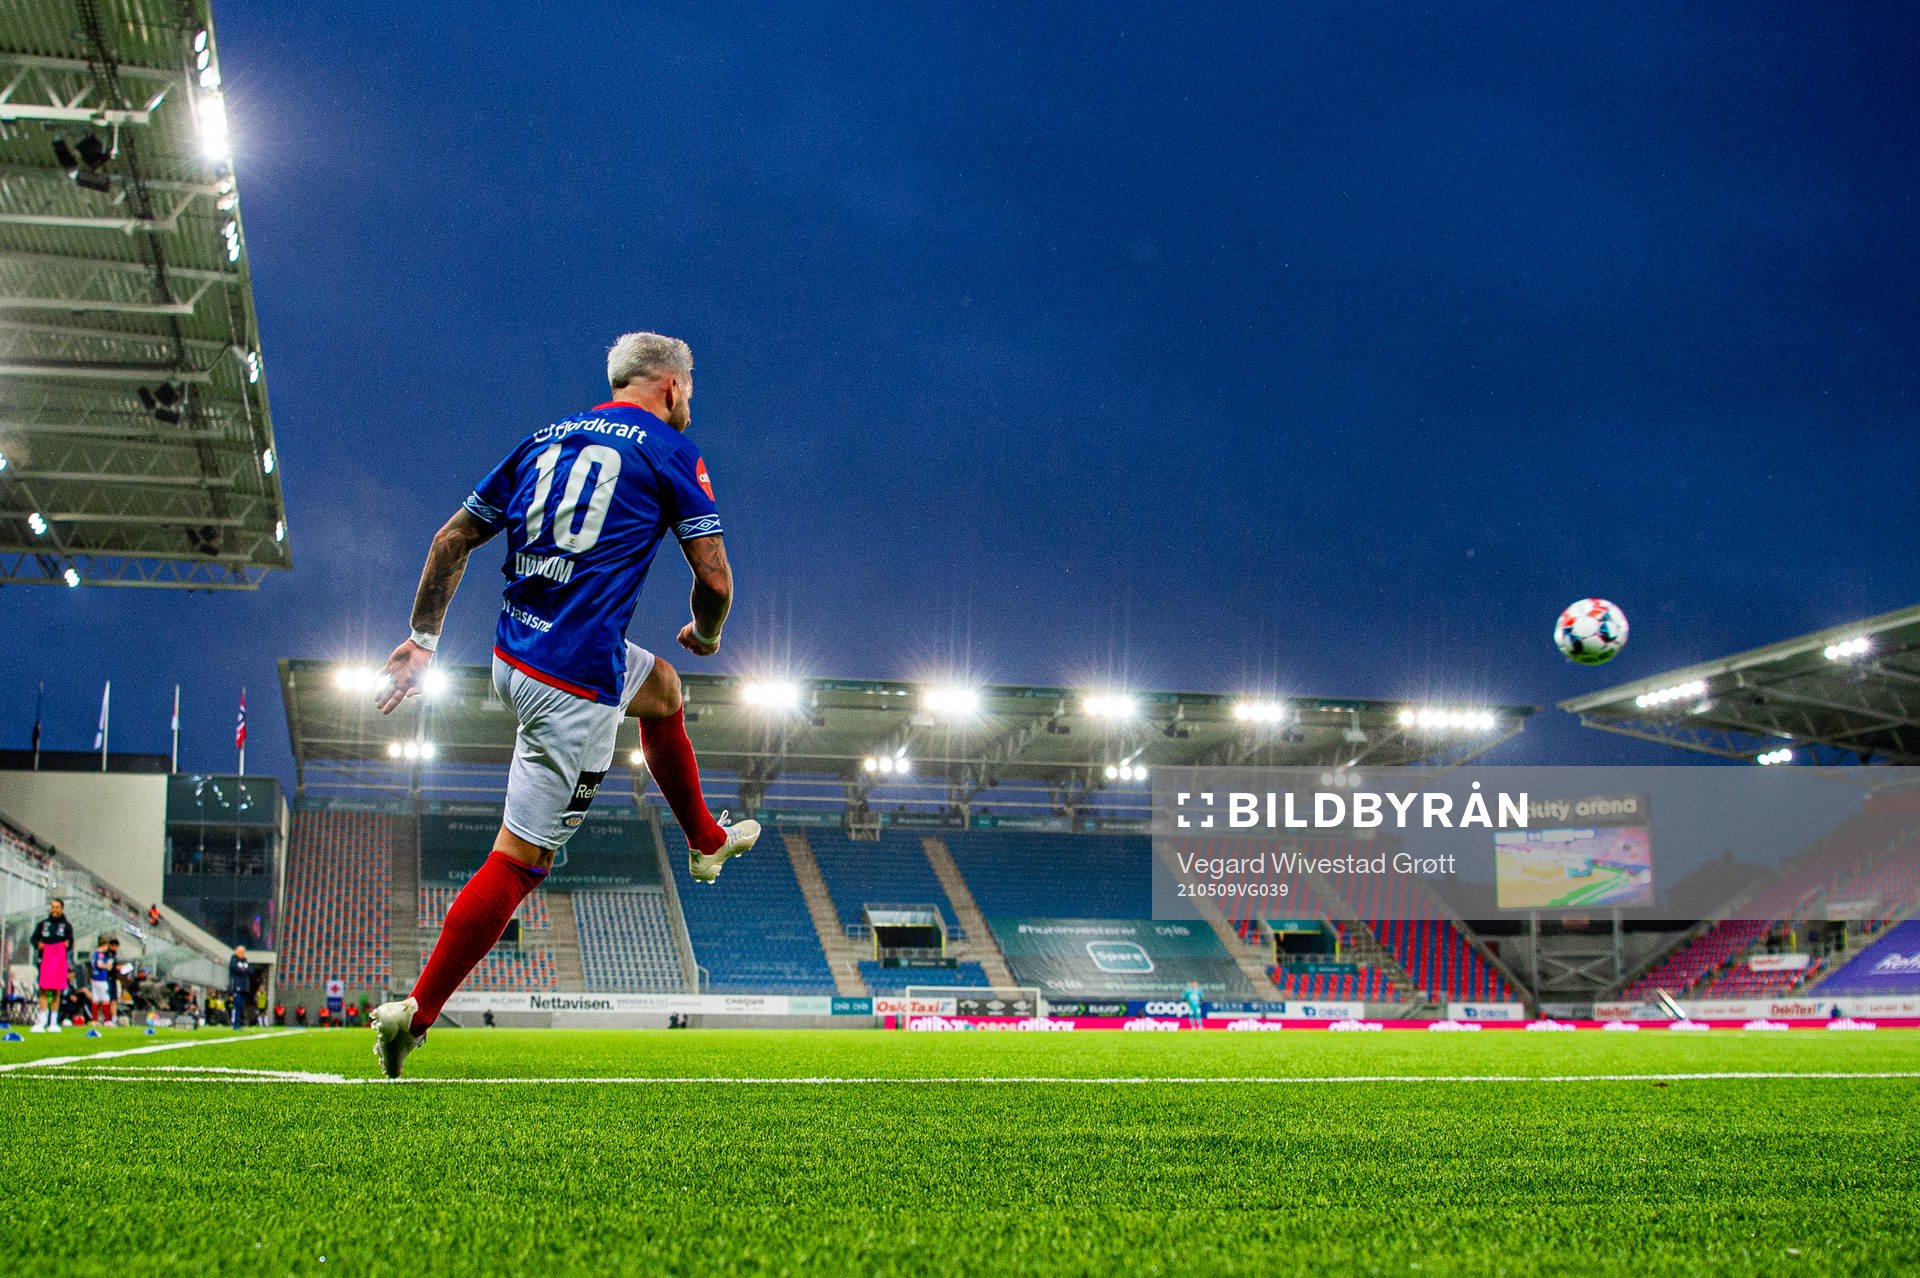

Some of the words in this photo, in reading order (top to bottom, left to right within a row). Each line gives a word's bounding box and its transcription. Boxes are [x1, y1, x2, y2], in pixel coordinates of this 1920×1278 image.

[554, 418, 647, 444] fjordkraft
[526, 443, 622, 553] 10
[1575, 798, 1637, 816] arena
[530, 995, 615, 1010] Nettavisen.
